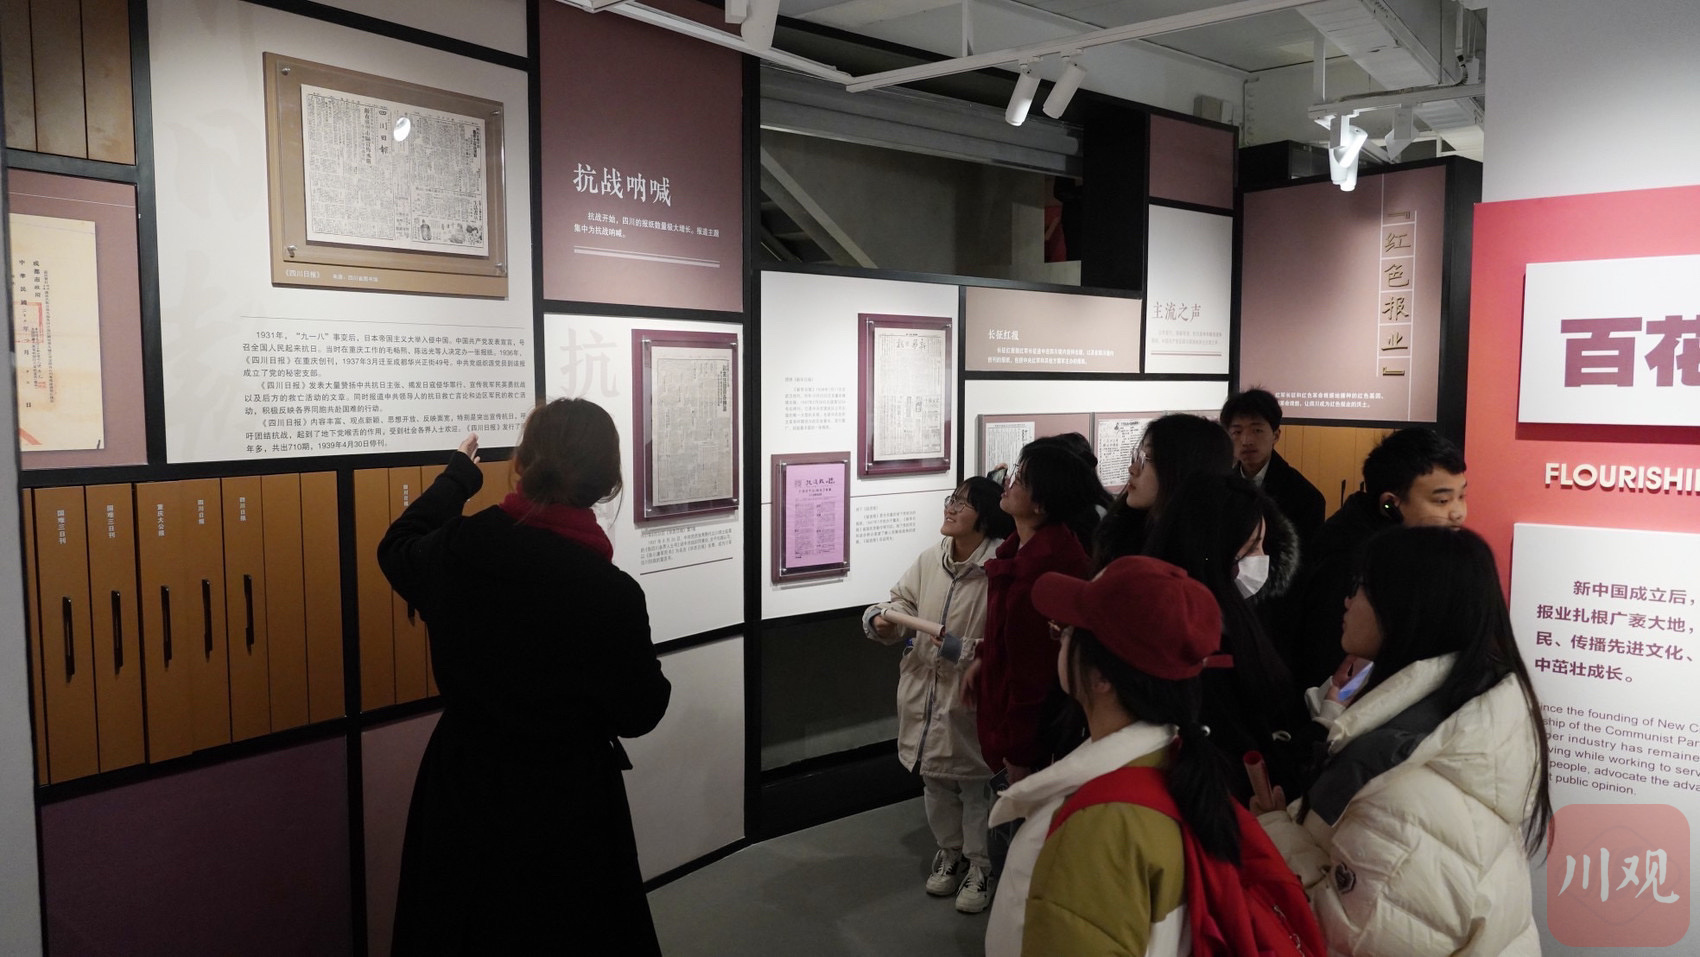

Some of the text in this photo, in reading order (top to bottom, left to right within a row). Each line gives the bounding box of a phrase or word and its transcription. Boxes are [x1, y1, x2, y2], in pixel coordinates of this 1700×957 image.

[573, 163, 672, 207] 抗战呐喊
[1152, 301, 1201, 322] 主流之声
[988, 328, 1020, 341] 长征红报
[560, 325, 620, 398] 抗
[1560, 314, 1700, 388] 百花
[243, 369, 322, 378] 成立了党的秘密支部。
[1573, 580, 1695, 606] 新中国成立后，
[1536, 604, 1694, 634] 报业扎根广袤大地，
[1536, 631, 1695, 662] 民、传播先进文化、
[1534, 657, 1633, 683] 中茁壮成长。
[1540, 702, 1563, 714] ince
[1567, 706, 1584, 717] the
[1588, 709, 1638, 726] founding
[1642, 717, 1655, 727] of
[1657, 718, 1685, 731] New
[1568, 734, 1616, 751] industry
[1621, 742, 1643, 754] has
[1569, 720, 1581, 730] of
[1583, 722, 1601, 733] the
[1605, 725, 1673, 744] Communist
[1575, 749, 1605, 762] while
[1609, 755, 1656, 772] working
[1659, 763, 1671, 773] to
[1556, 774, 1589, 787] public
[1592, 780, 1637, 796] opinion.
[1594, 767, 1647, 783] advocate
[1651, 776, 1669, 787] the
